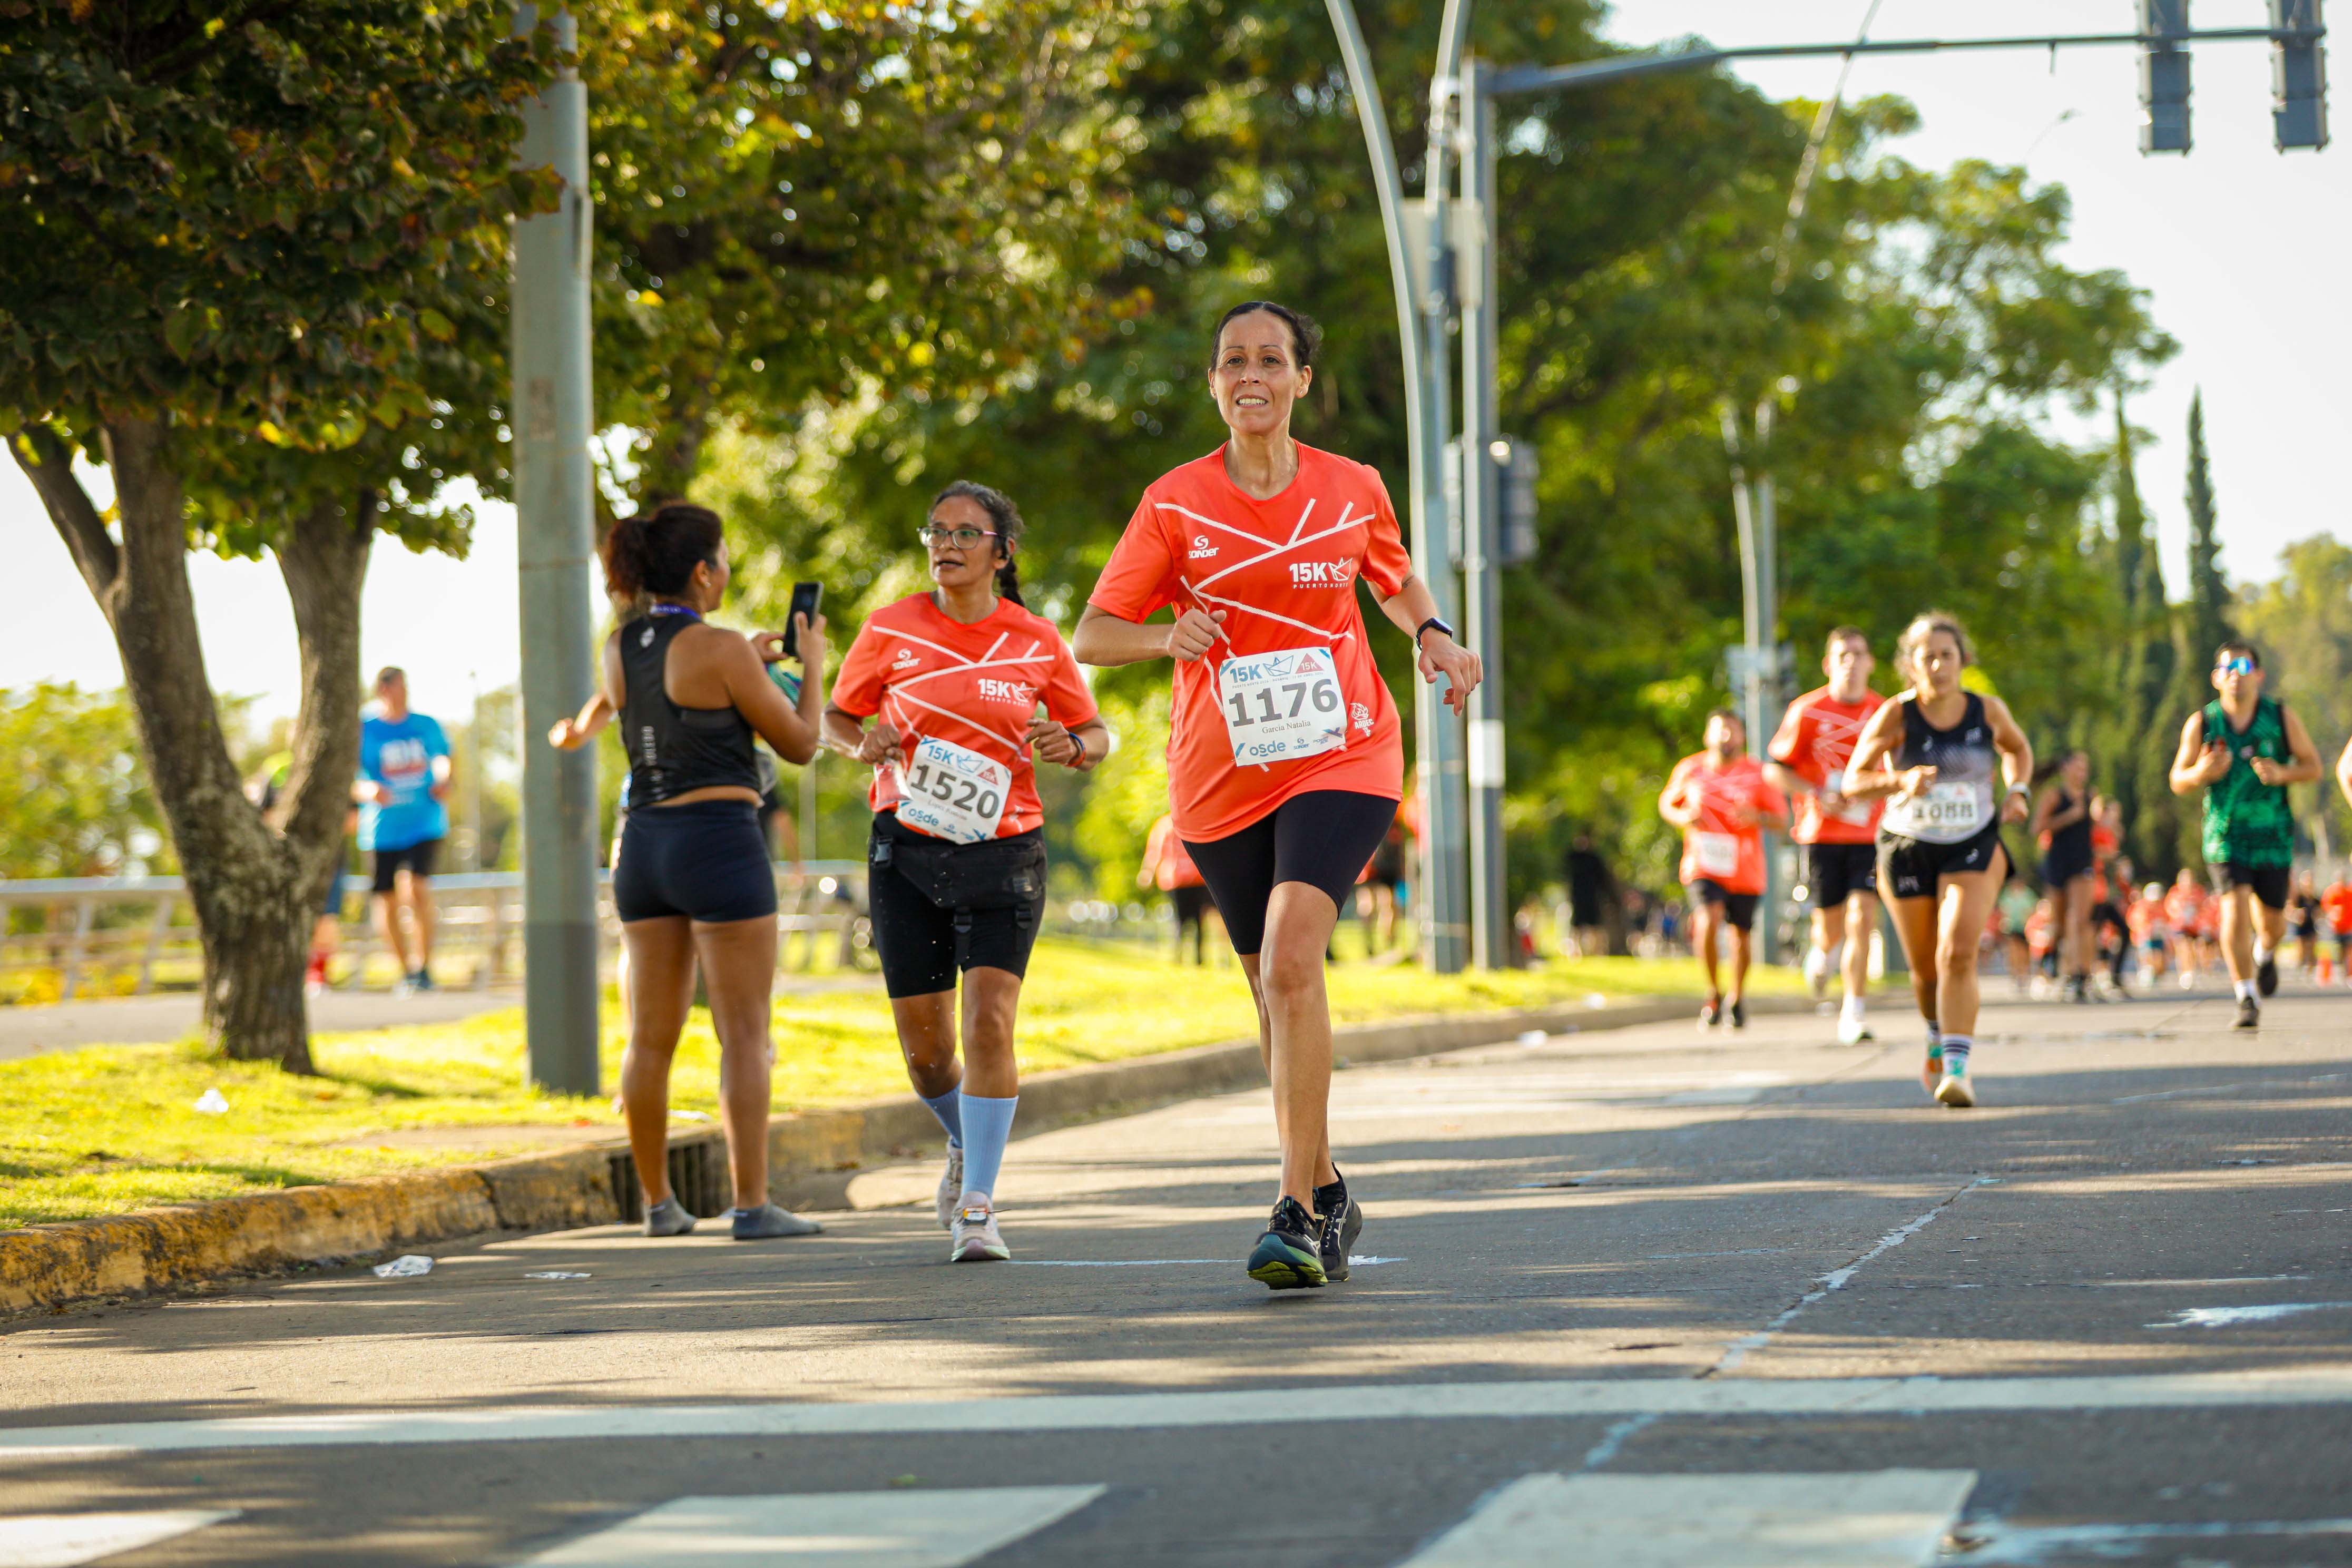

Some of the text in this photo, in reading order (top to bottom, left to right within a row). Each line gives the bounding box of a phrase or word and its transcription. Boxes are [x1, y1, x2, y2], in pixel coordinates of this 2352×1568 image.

[1289, 562, 1328, 582] 15K
[1230, 664, 1263, 683] 15K
[1301, 661, 1318, 671] 15K
[978, 678, 1012, 699] 15K
[1228, 679, 1338, 727] 1176
[1262, 720, 1311, 734] Garcia Natalia
[1354, 718, 1375, 730] ARDEC
[928, 745, 955, 765] 15K
[1249, 740, 1286, 757] osde
[910, 763, 1000, 819] 1520
[908, 809, 939, 827] osde
